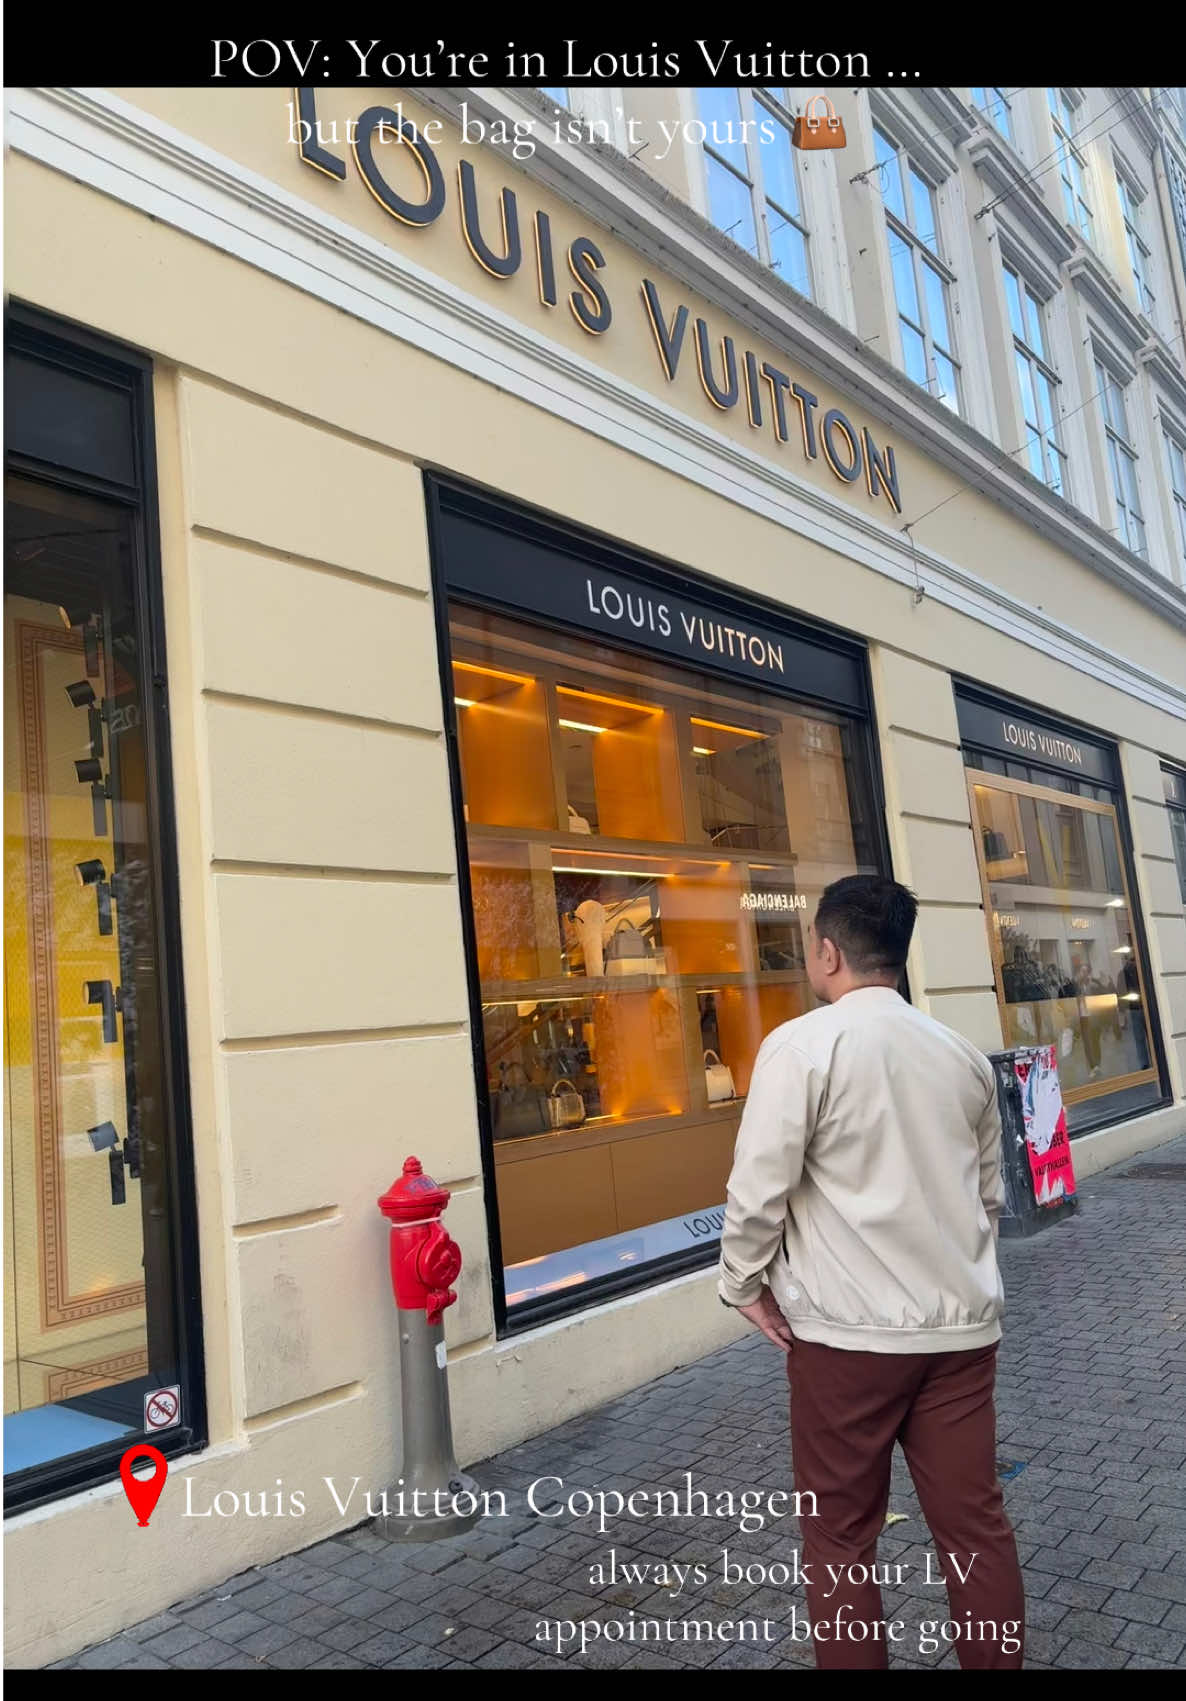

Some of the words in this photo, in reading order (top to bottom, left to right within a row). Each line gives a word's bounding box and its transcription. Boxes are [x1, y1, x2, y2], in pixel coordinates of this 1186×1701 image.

[294, 87, 613, 335] LOUIS
[640, 278, 902, 515] VUITTON
[586, 578, 672, 638] LOUIS
[679, 611, 784, 674] VUITTON
[1002, 720, 1037, 752] LOUIS
[1037, 733, 1082, 765] VUITTON
